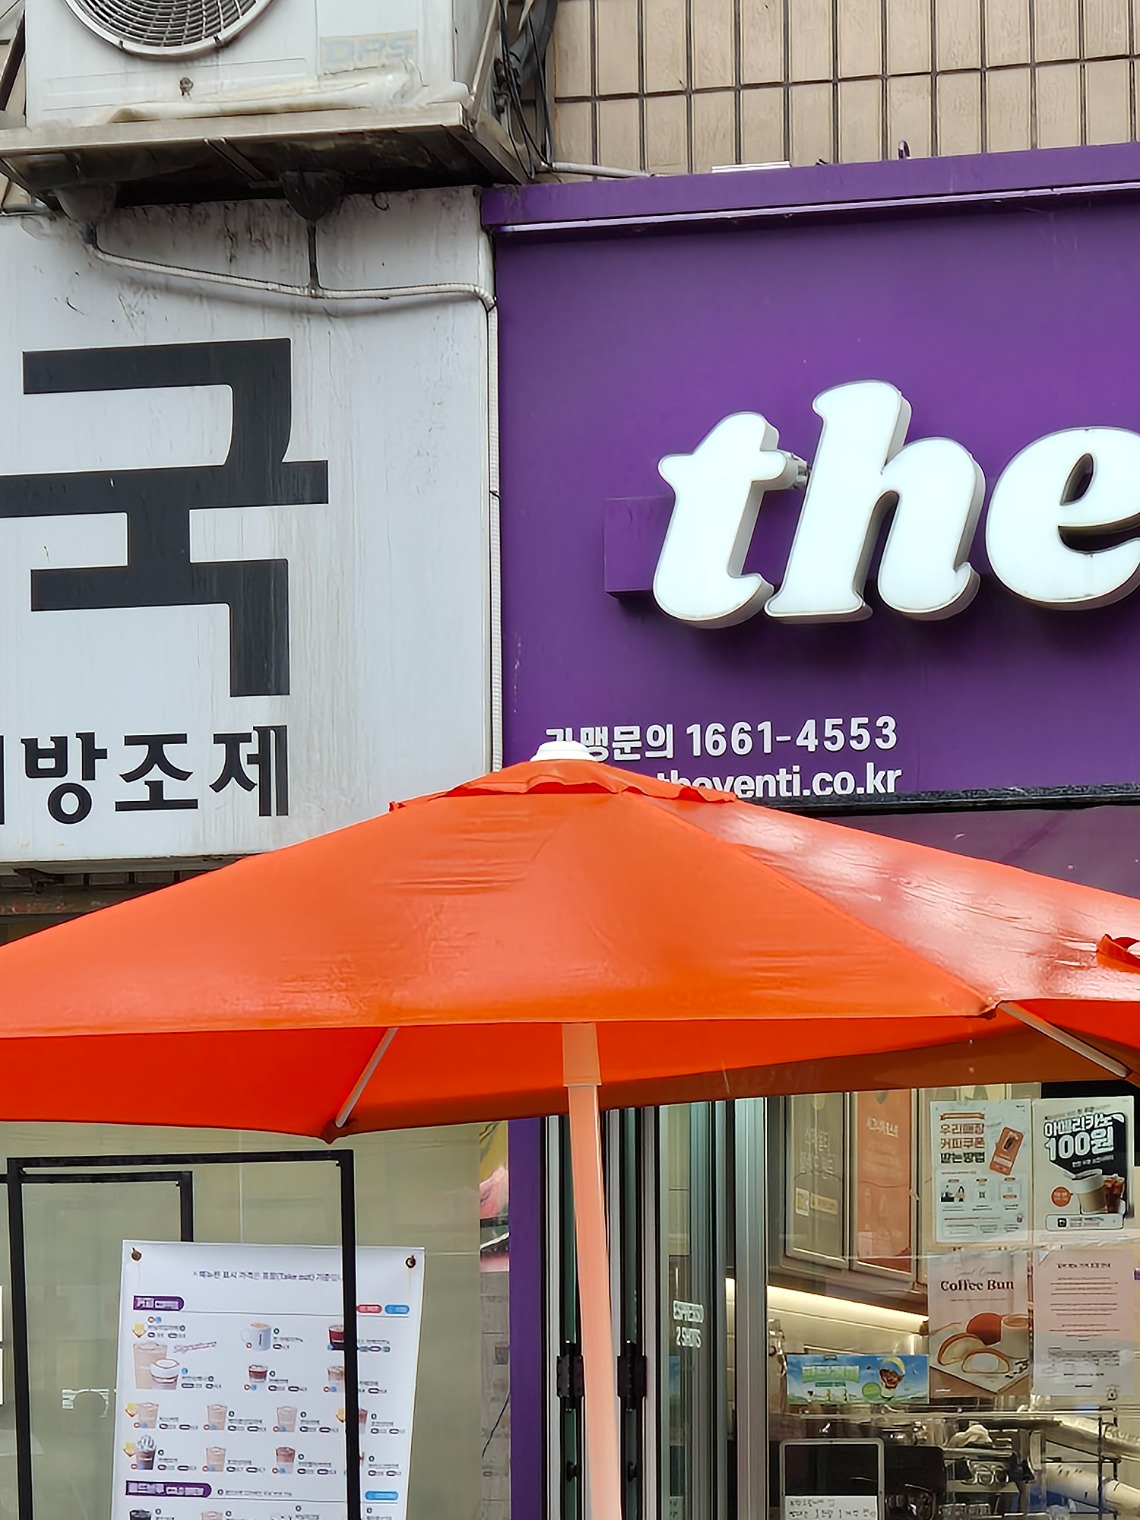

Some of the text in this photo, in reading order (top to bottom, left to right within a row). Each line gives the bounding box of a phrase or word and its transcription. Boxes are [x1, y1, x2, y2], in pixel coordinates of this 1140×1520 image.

[0, 338, 328, 698] 국
[686, 715, 898, 757] 1661-4553
[0, 725, 288, 825] 방조제
[1044, 1112, 1113, 1137] 아메리카노
[1045, 1126, 1114, 1161] 100원
[940, 1279, 1015, 1291] Coffee Bun
